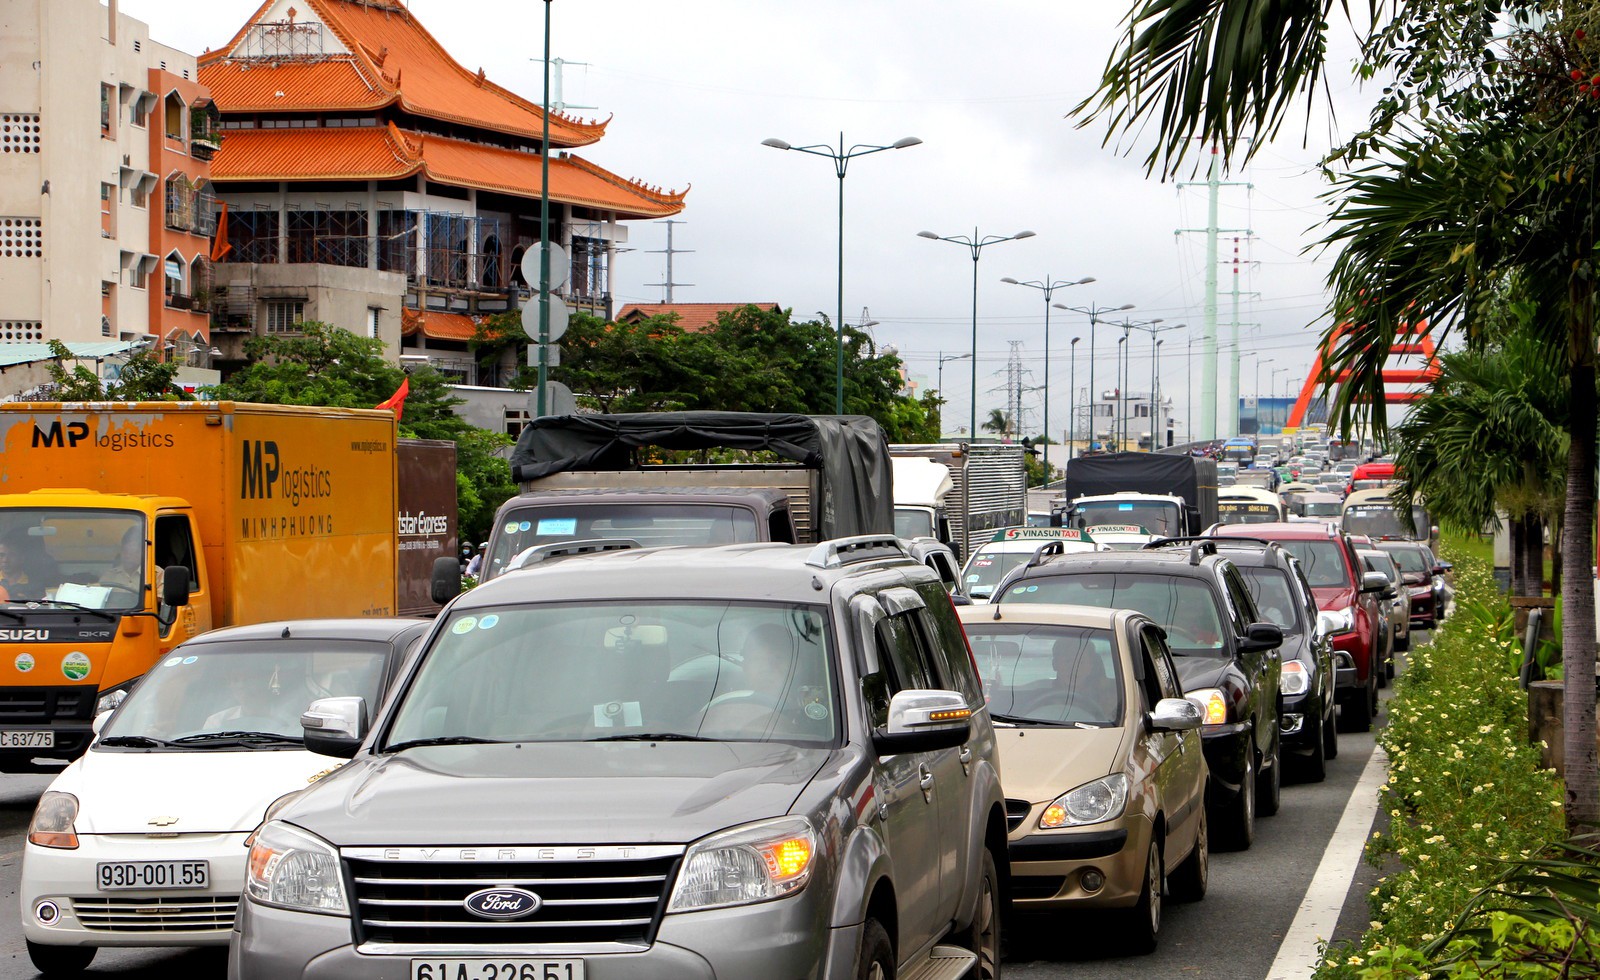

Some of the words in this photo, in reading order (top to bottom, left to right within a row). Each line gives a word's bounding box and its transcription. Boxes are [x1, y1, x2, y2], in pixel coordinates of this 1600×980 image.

[32, 421, 90, 448] MP
[94, 430, 174, 452] logistics
[240, 439, 280, 499] MP
[281, 462, 332, 507] logistics
[398, 510, 418, 534] tstar
[418, 510, 448, 539] Express
[0, 629, 49, 641] SUZU
[0, 732, 52, 746] C-637.75
[383, 846, 636, 861] EVEREST
[101, 863, 205, 886] 93D-001.55
[481, 893, 523, 910] Ford
[417, 962, 574, 980] 61A-32651
